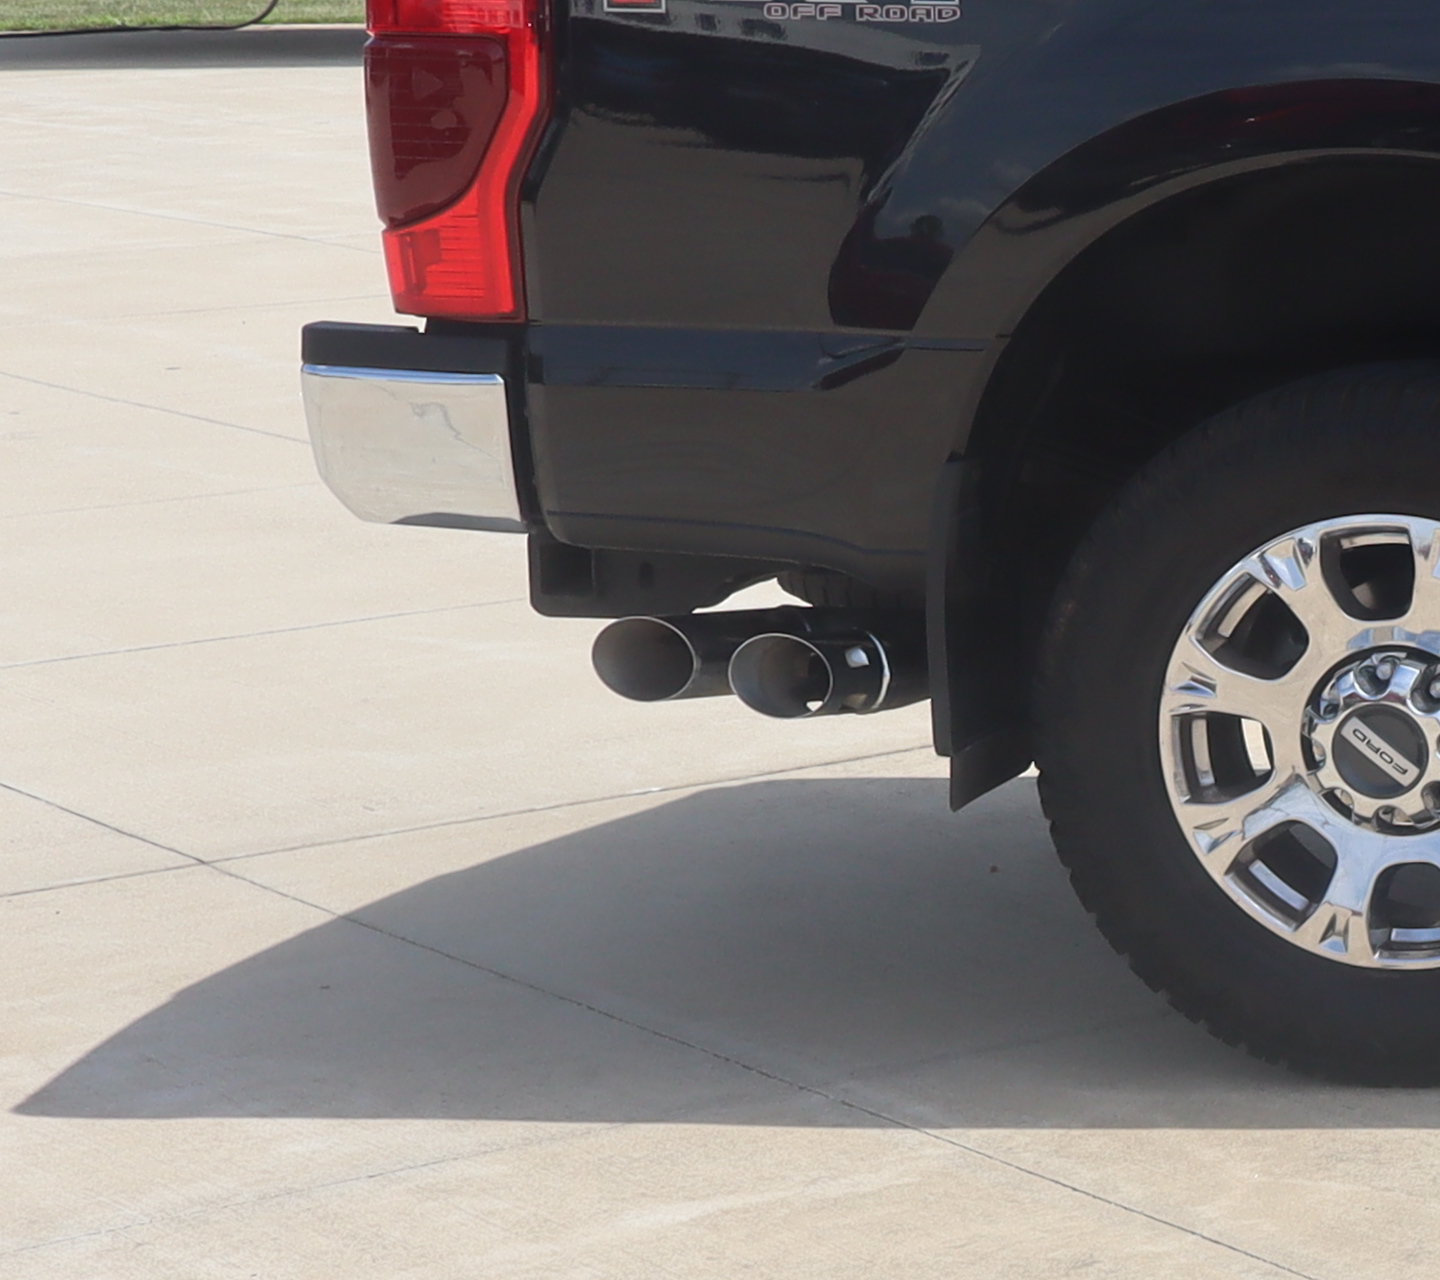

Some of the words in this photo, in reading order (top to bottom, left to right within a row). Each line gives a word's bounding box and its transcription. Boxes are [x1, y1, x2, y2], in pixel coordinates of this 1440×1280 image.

[763, 3, 842, 21] OFF
[855, 4, 961, 22] ROAD
[1352, 727, 1409, 776] FORD
